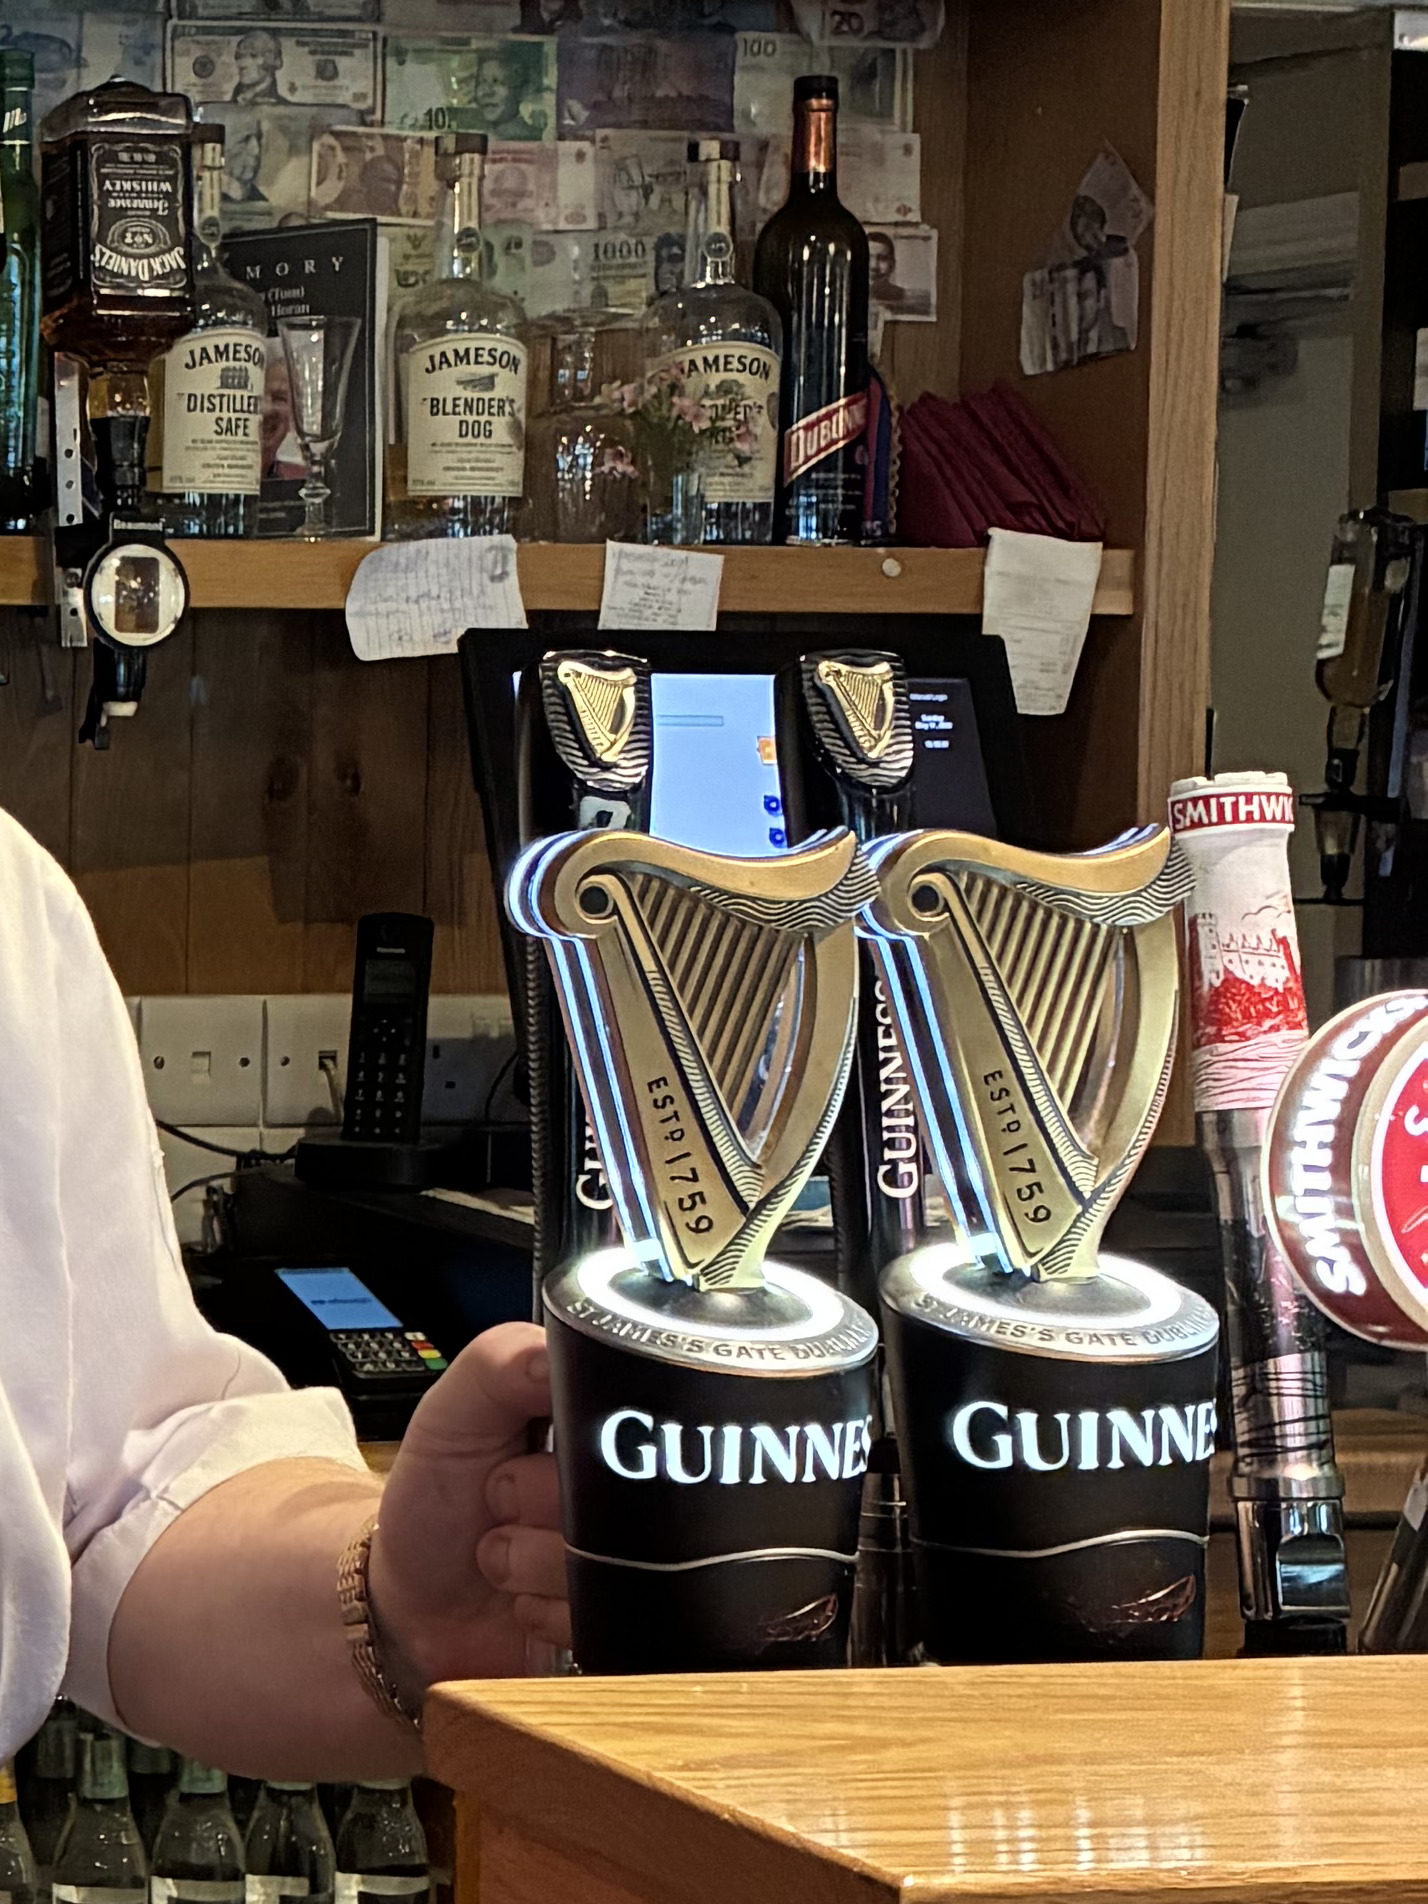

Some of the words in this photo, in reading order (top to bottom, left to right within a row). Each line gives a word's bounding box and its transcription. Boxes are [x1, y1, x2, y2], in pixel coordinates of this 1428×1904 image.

[103, 179, 173, 193] WHISKEY
[149, 246, 187, 277] JACK
[245, 255, 344, 281] MORY
[424, 346, 521, 376] JAMESON
[687, 354, 771, 381] AMESON
[429, 396, 516, 418] BLENDER'S
[213, 416, 250, 437] SAFE
[458, 419, 493, 439] DOG
[663, 1150, 715, 1235] 1759
[1002, 1142, 1053, 1224] 1759
[1064, 1330, 1139, 1347] GATE
[713, 1341, 787, 1361] GATE
